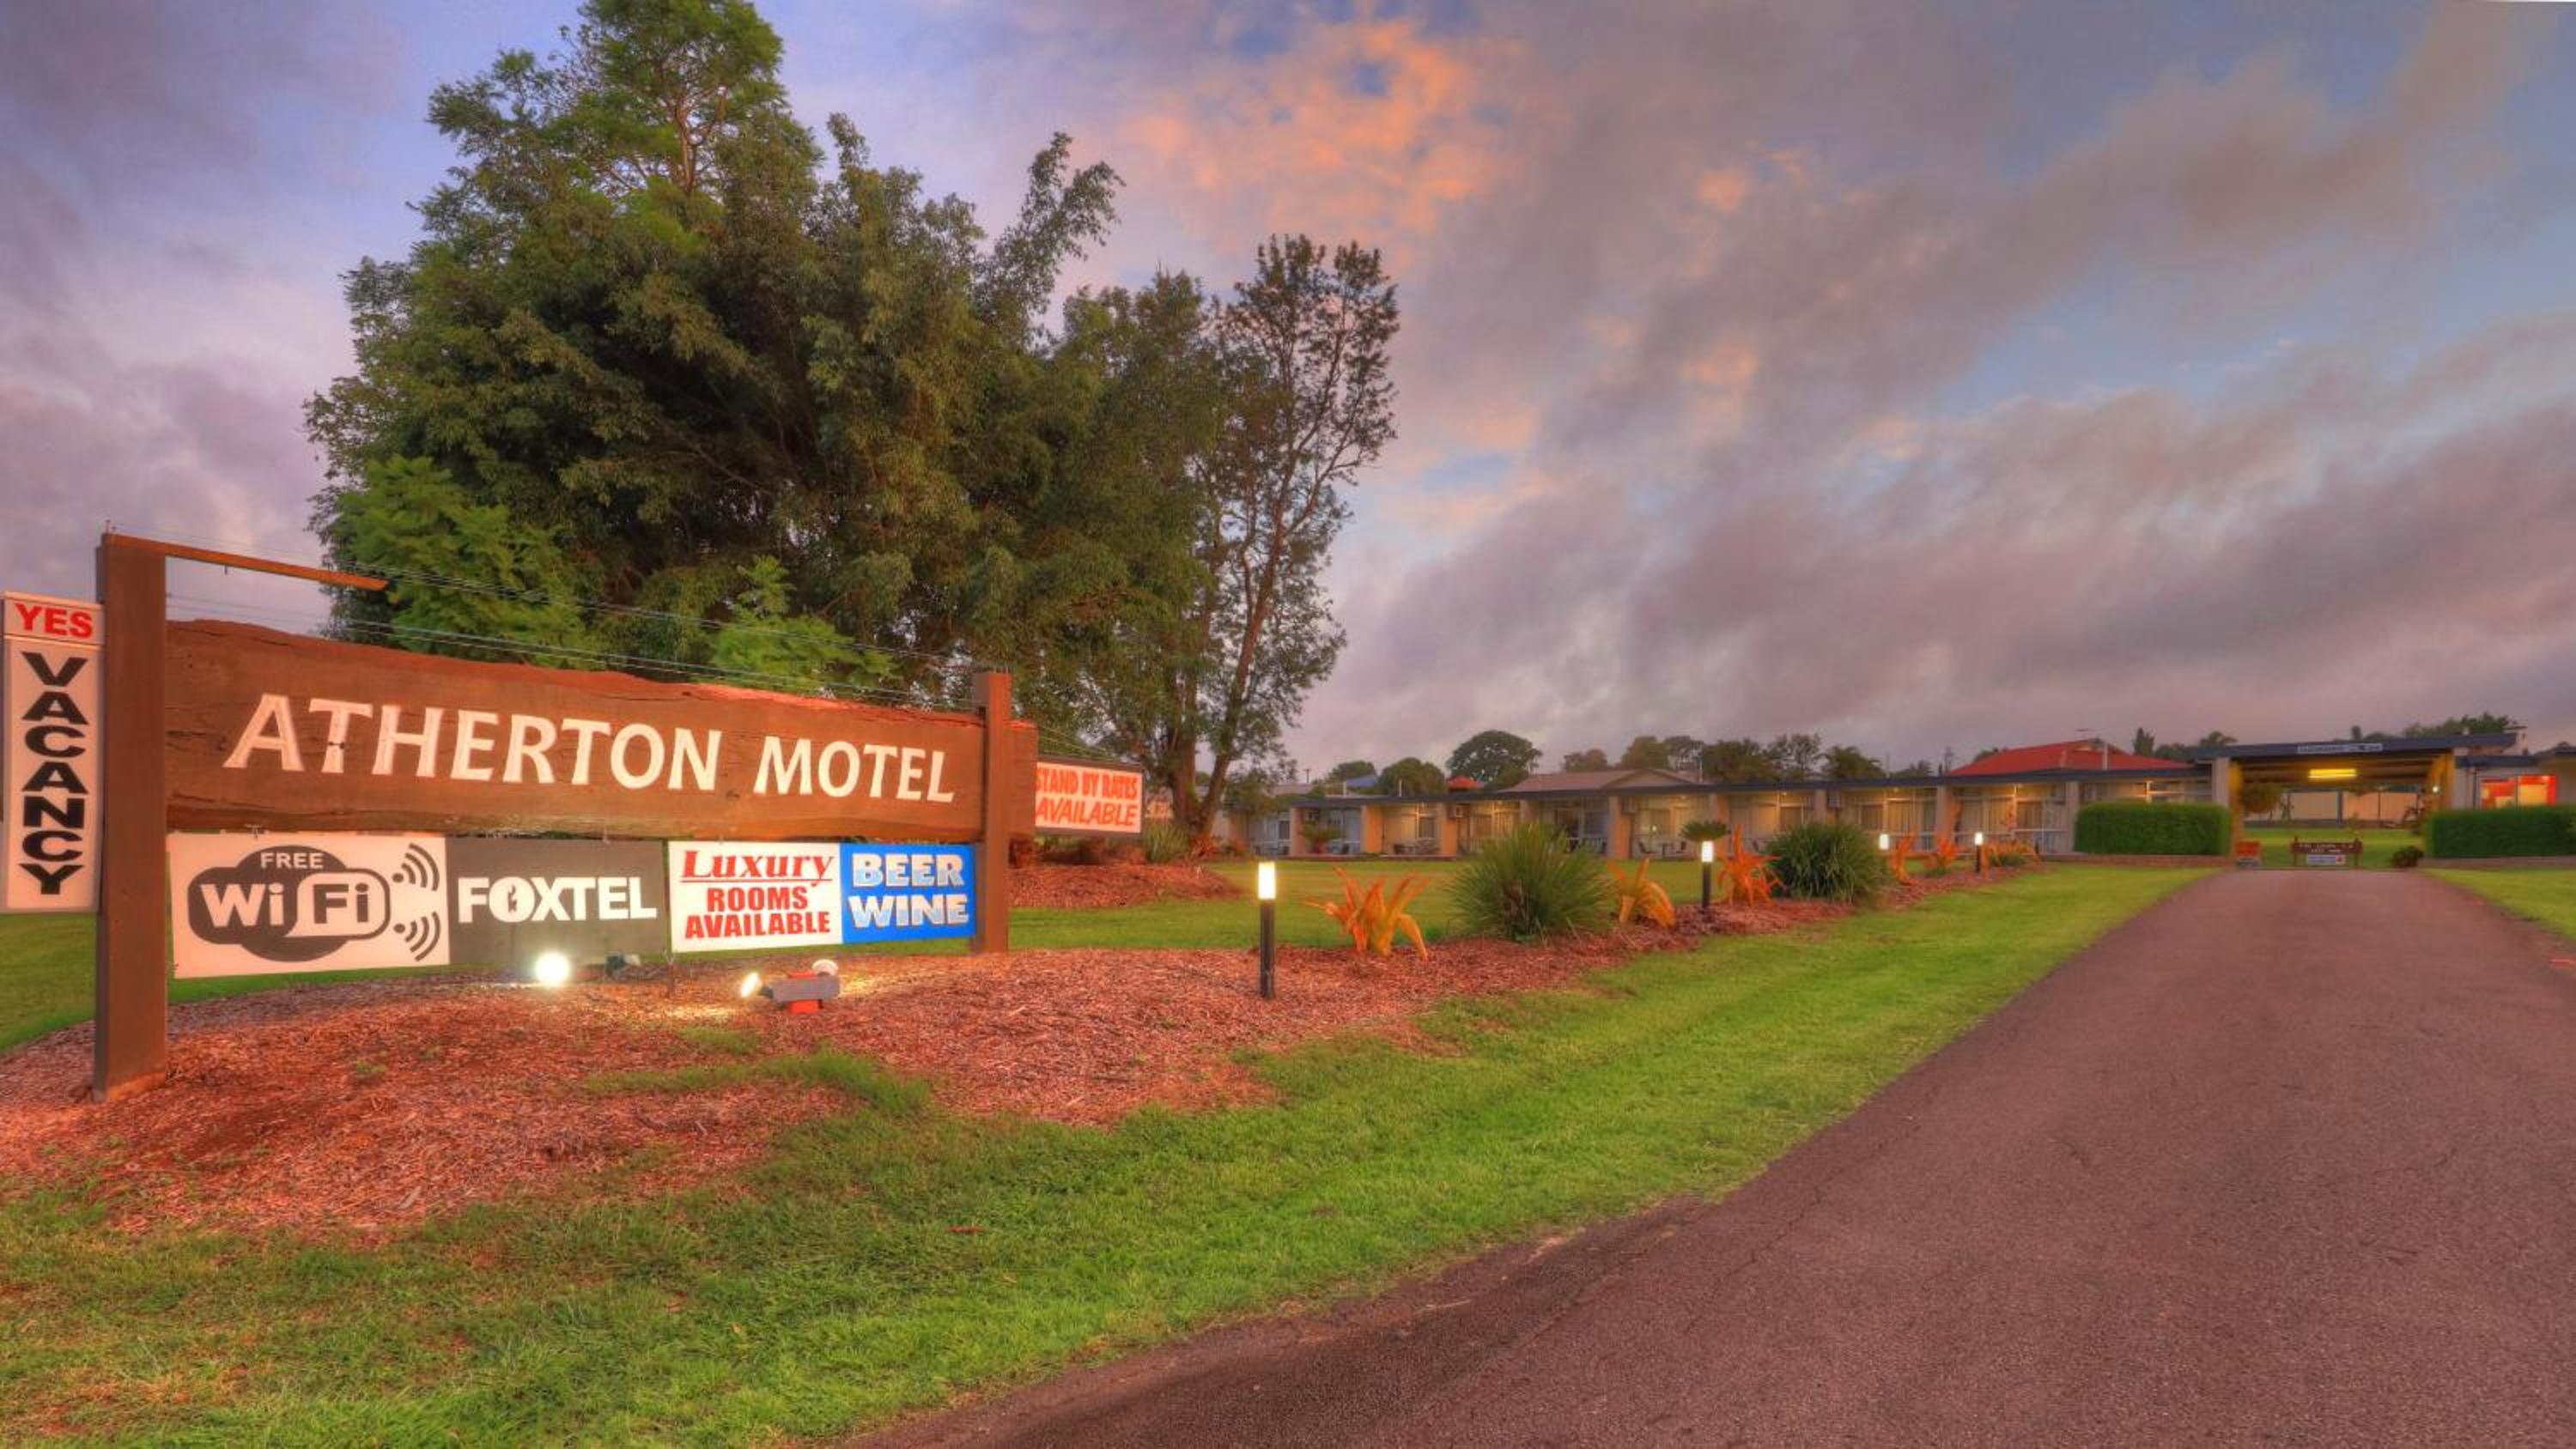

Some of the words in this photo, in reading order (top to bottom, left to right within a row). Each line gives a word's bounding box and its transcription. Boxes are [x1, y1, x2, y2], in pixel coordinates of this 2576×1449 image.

[15, 603, 93, 638] YES
[222, 693, 721, 791] ATHERTON
[753, 737, 955, 804] MOTEL
[18, 651, 88, 894] VACANCY
[1082, 771, 1100, 797] BY
[1103, 774, 1138, 799] RATES
[1036, 797, 1138, 827] AVAILABLE
[260, 852, 324, 870] FREE
[681, 850, 835, 887] Luxury
[852, 852, 965, 888] BEER
[458, 876, 658, 923] FOXTEL
[707, 886, 808, 912] ROOMS
[848, 894, 969, 929] WINE
[685, 911, 830, 939] AVAILABLE
